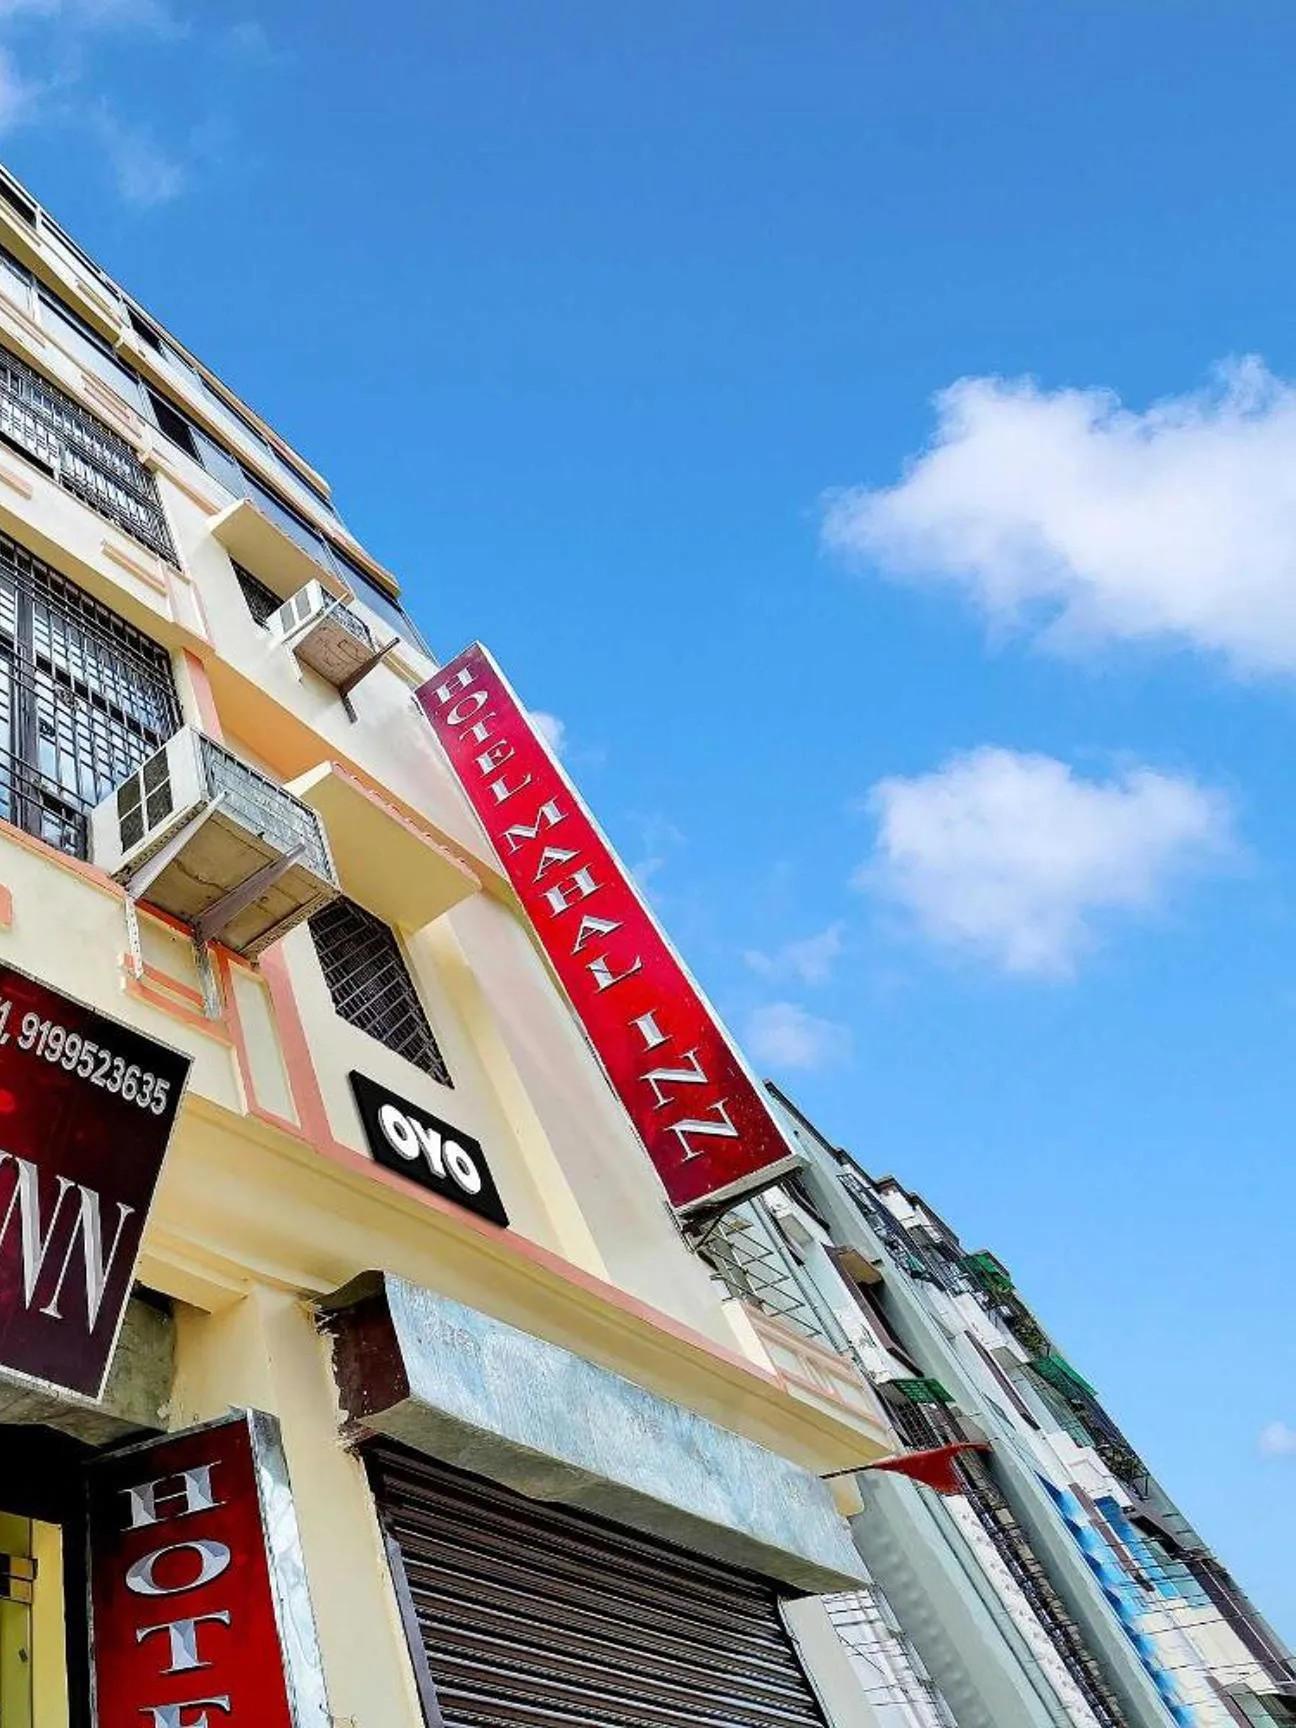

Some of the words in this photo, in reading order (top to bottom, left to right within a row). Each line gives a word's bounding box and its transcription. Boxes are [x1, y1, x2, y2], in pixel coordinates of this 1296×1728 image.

[433, 663, 532, 804] HOTEL
[500, 797, 642, 993] MAHAL
[629, 1008, 740, 1162] INN
[16, 1012, 171, 1115] 9199523635
[377, 1103, 482, 1195] OYO
